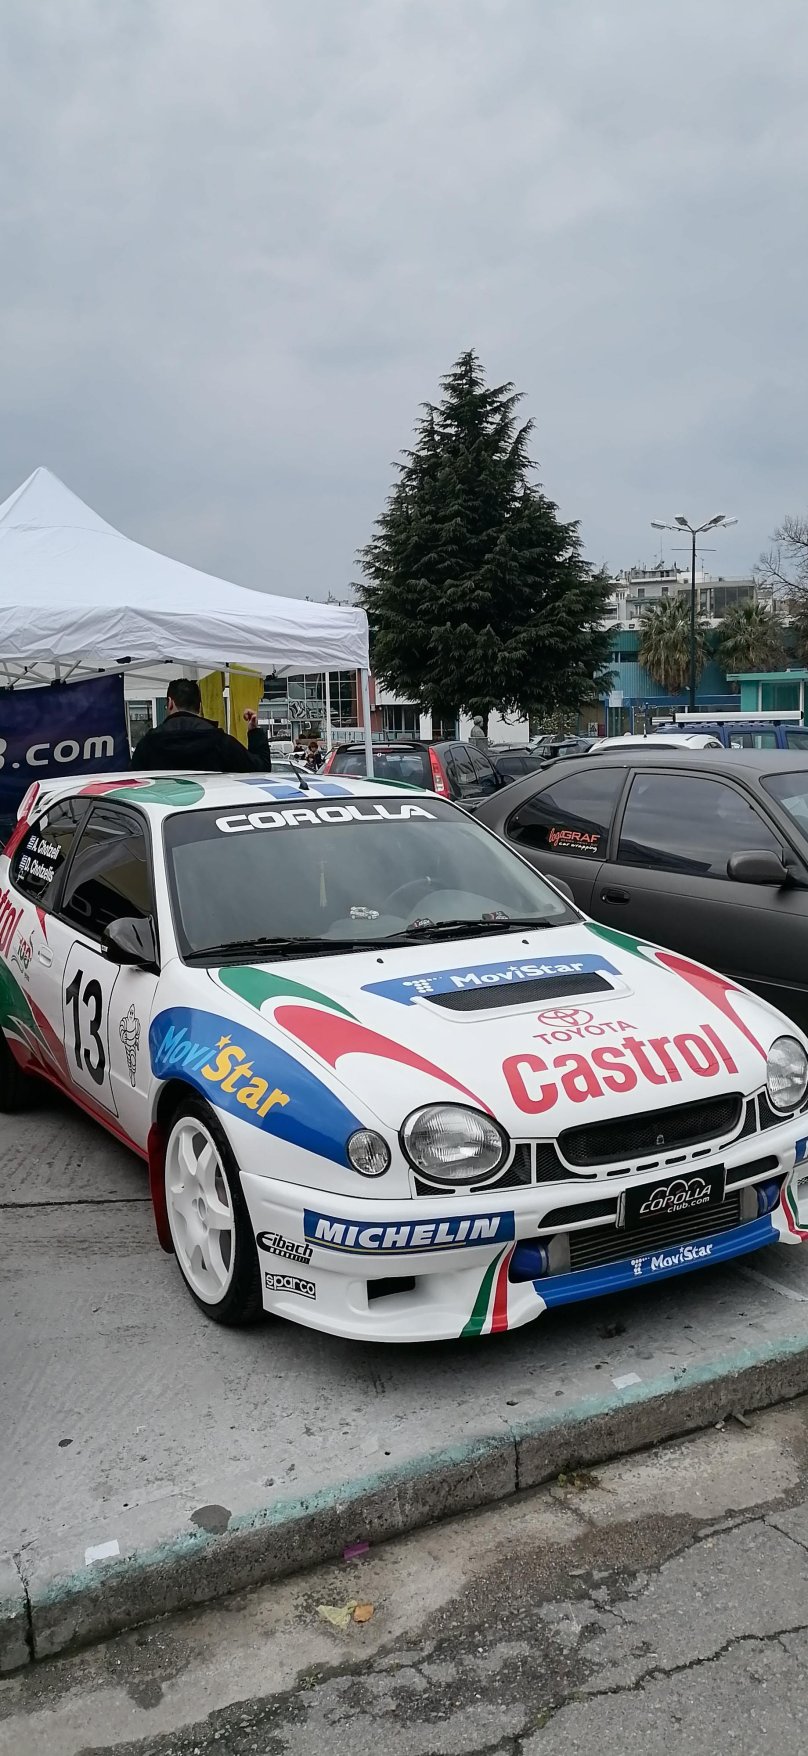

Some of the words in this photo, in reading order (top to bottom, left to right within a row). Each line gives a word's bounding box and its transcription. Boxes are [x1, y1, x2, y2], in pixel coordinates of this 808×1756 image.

[215, 804, 438, 833] COROLLA
[450, 961, 584, 989] MoviStar
[65, 968, 106, 1086] 13
[532, 1020, 638, 1045] TOYOTA
[501, 1023, 740, 1115] Castrol
[667, 1196, 710, 1213] club.com
[256, 1231, 313, 1260] Eibach
[314, 1216, 501, 1248] MICHELIN
[650, 1243, 713, 1271] MoviStar
[265, 1274, 316, 1295] sparco
